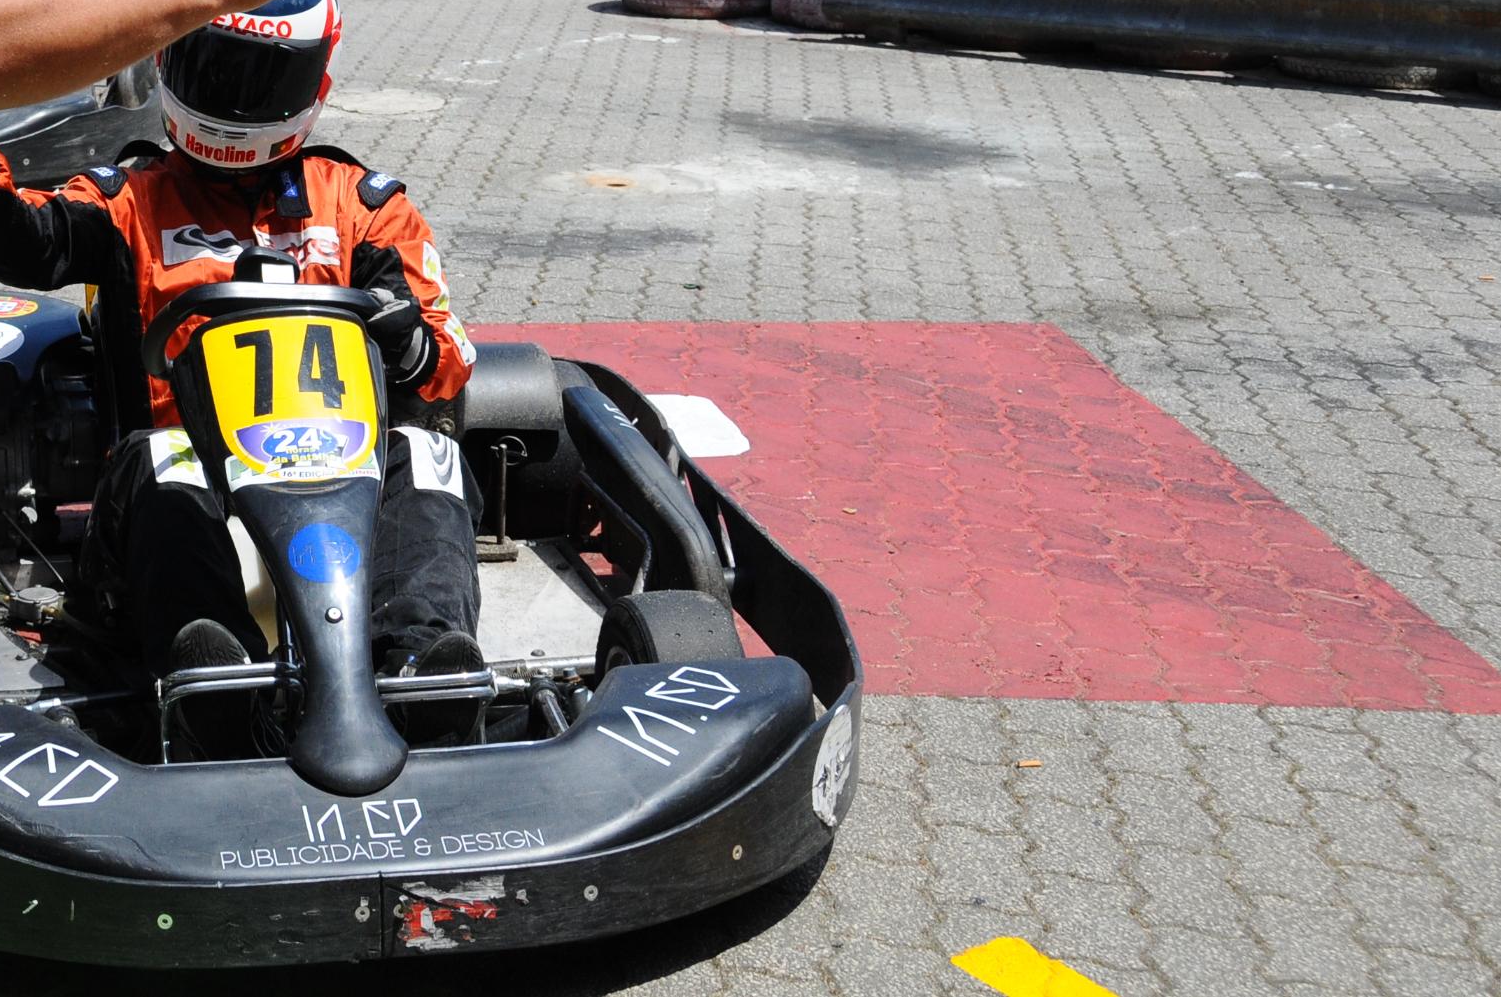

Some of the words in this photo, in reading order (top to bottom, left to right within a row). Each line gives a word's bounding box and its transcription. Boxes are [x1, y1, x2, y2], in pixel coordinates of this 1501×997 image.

[210, 12, 293, 40] EXACO
[185, 133, 257, 163] Havoline
[272, 427, 323, 454] 24
[272, 455, 288, 465] da
[219, 840, 406, 870] PUBLICIDADE
[414, 837, 432, 857] &
[441, 828, 546, 855] DESIGN
